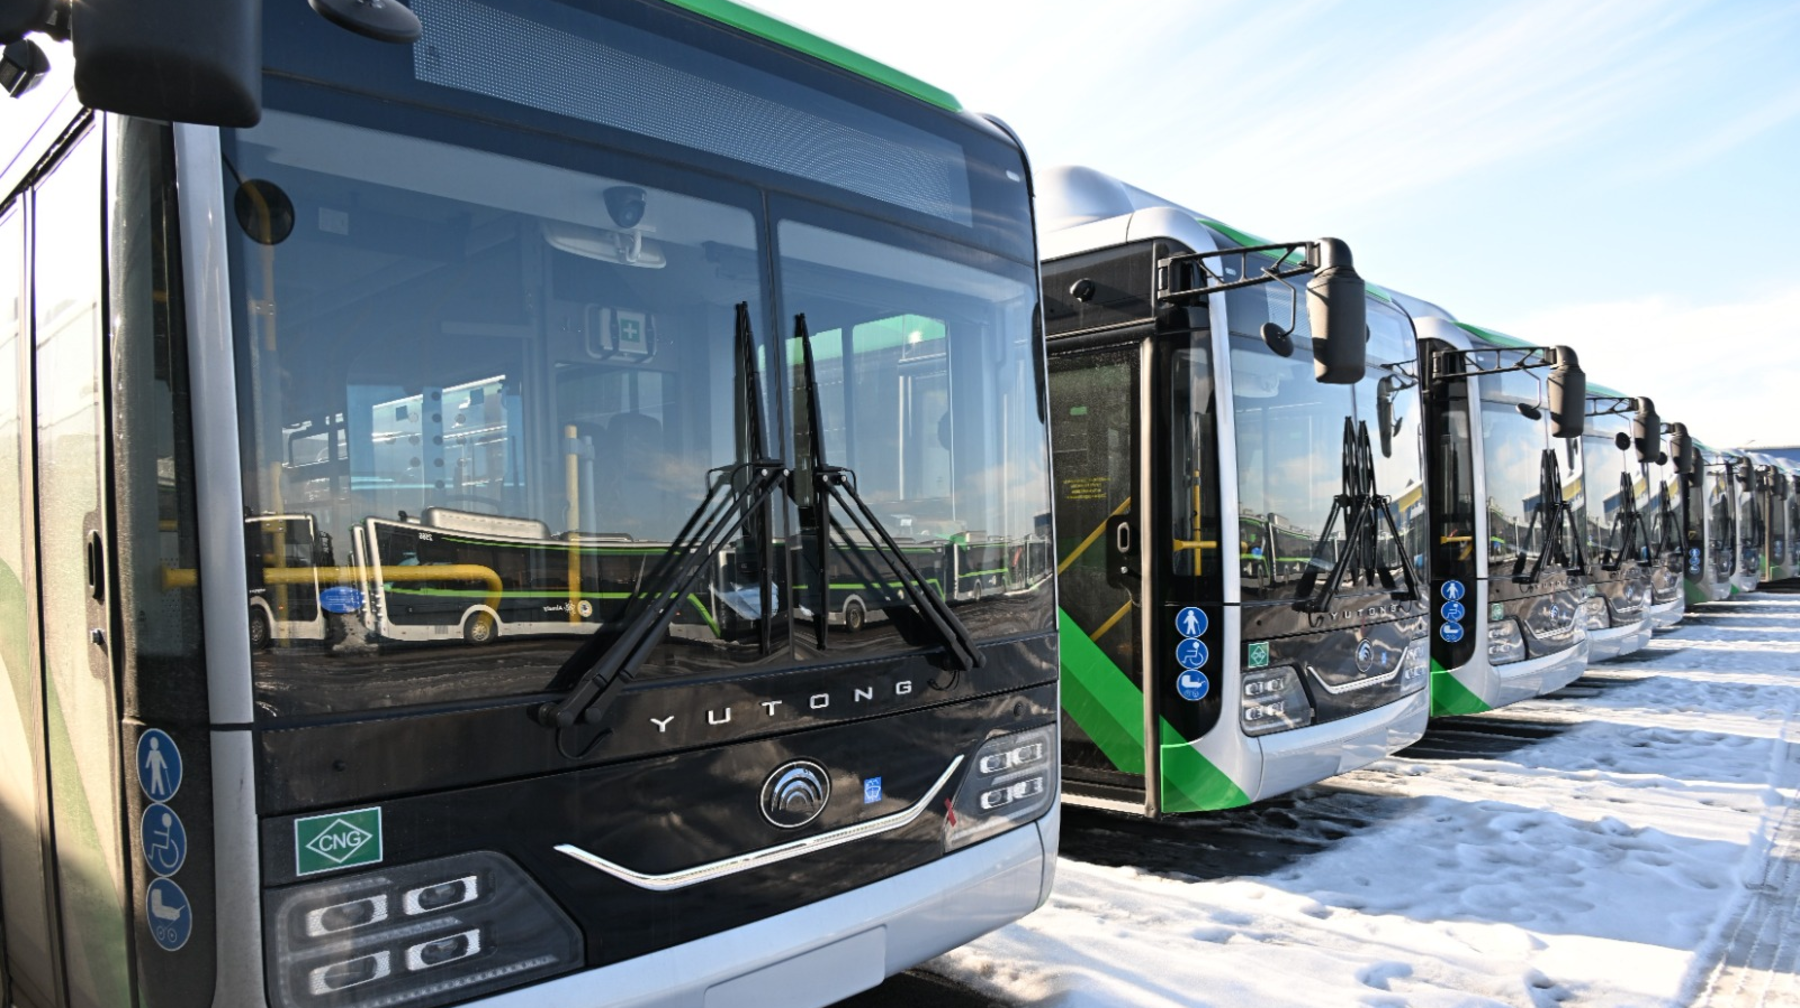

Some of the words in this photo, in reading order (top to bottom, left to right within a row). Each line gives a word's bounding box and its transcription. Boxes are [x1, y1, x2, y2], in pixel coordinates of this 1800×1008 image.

[1331, 603, 1398, 620] YUTONG
[650, 680, 912, 733] YUTONG
[318, 830, 361, 852] CNG
